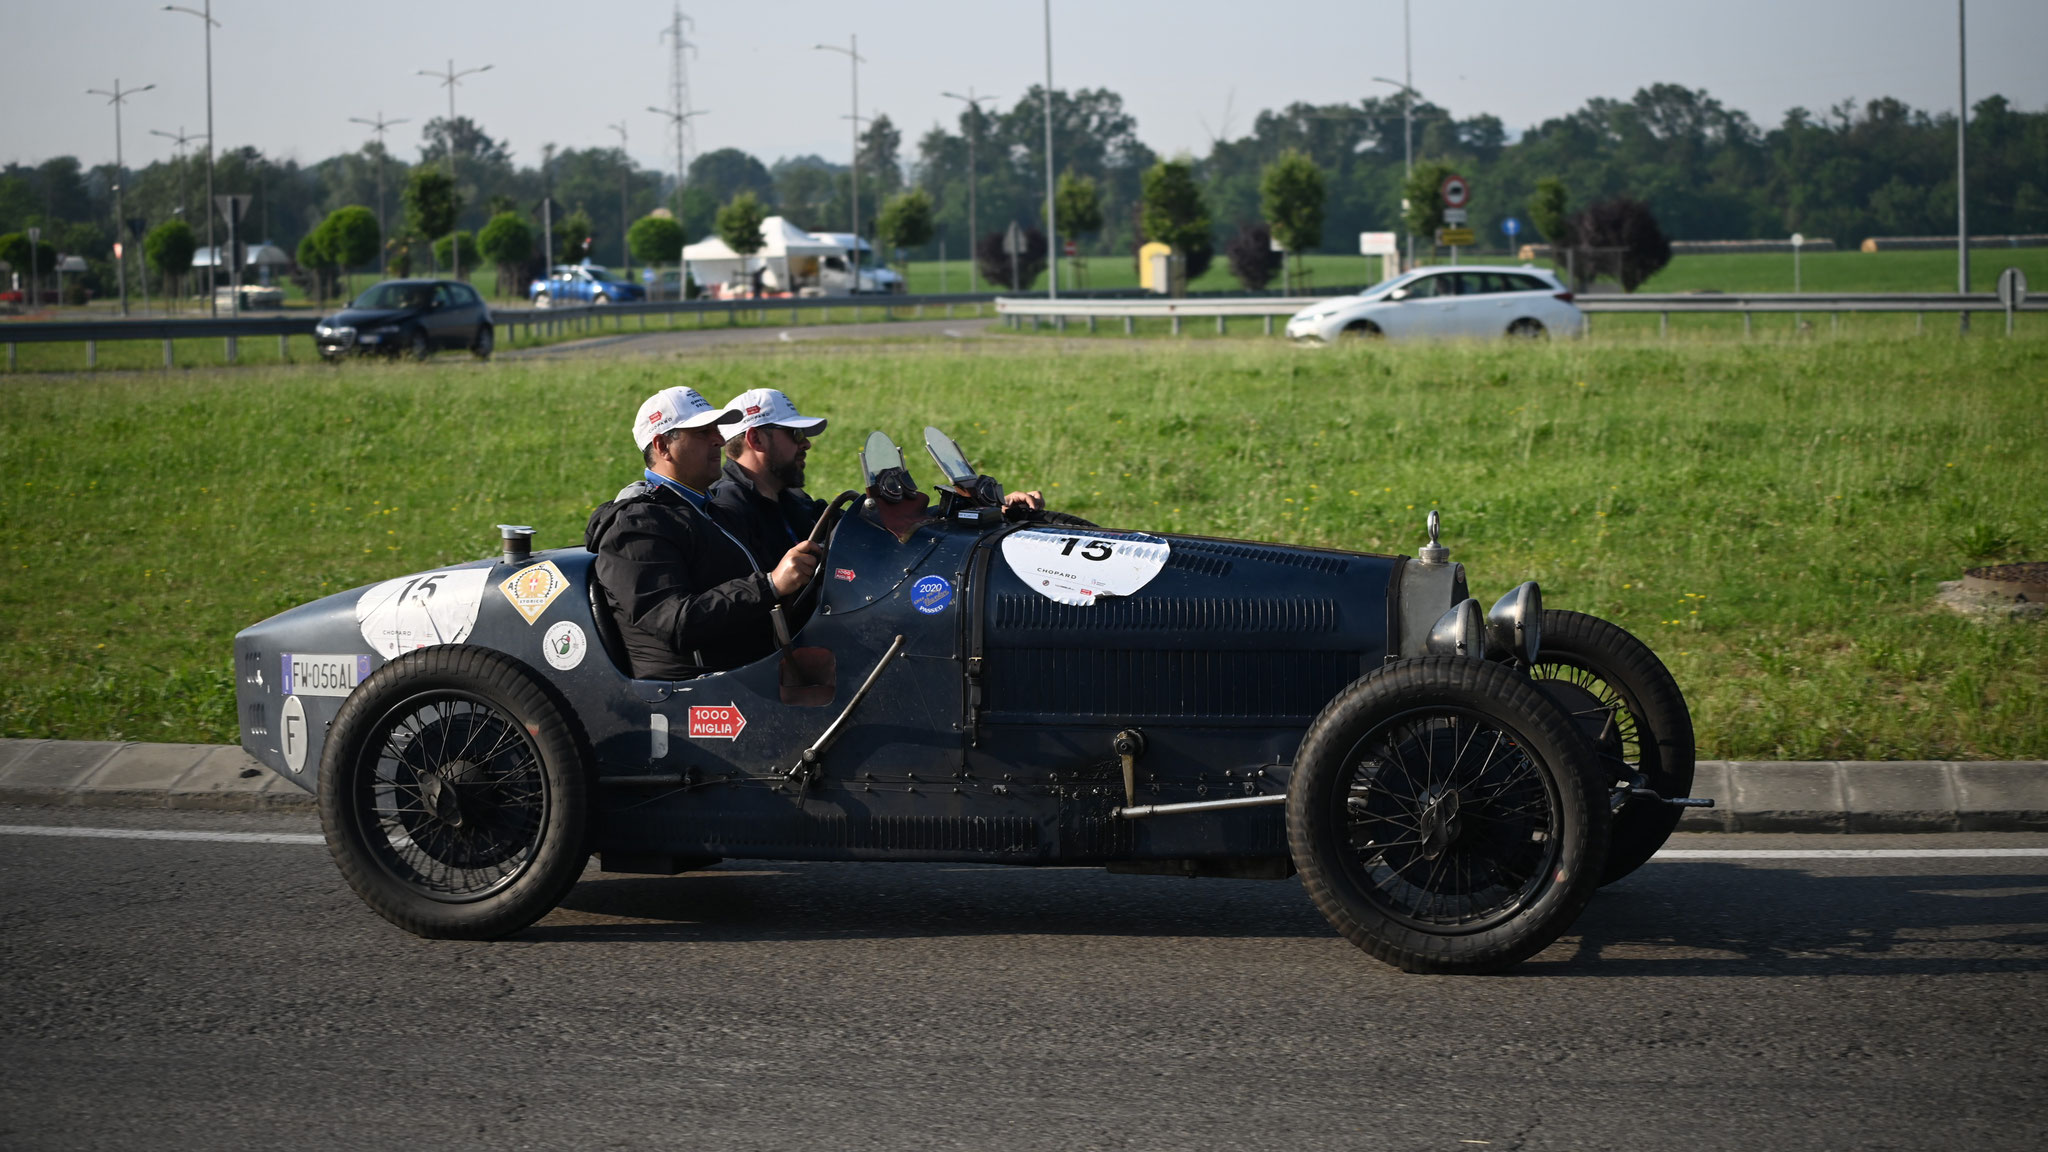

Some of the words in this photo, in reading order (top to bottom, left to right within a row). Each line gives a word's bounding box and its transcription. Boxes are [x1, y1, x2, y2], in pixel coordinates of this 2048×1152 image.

[1060, 537, 1116, 562] 15
[1036, 567, 1077, 580] CHOPARD
[397, 575, 448, 606] 15
[919, 583, 943, 593] 2020
[919, 604, 944, 613] PASSED
[695, 710, 729, 720] 1000
[693, 723, 732, 734] MIGLIA
[286, 715, 300, 755] F
